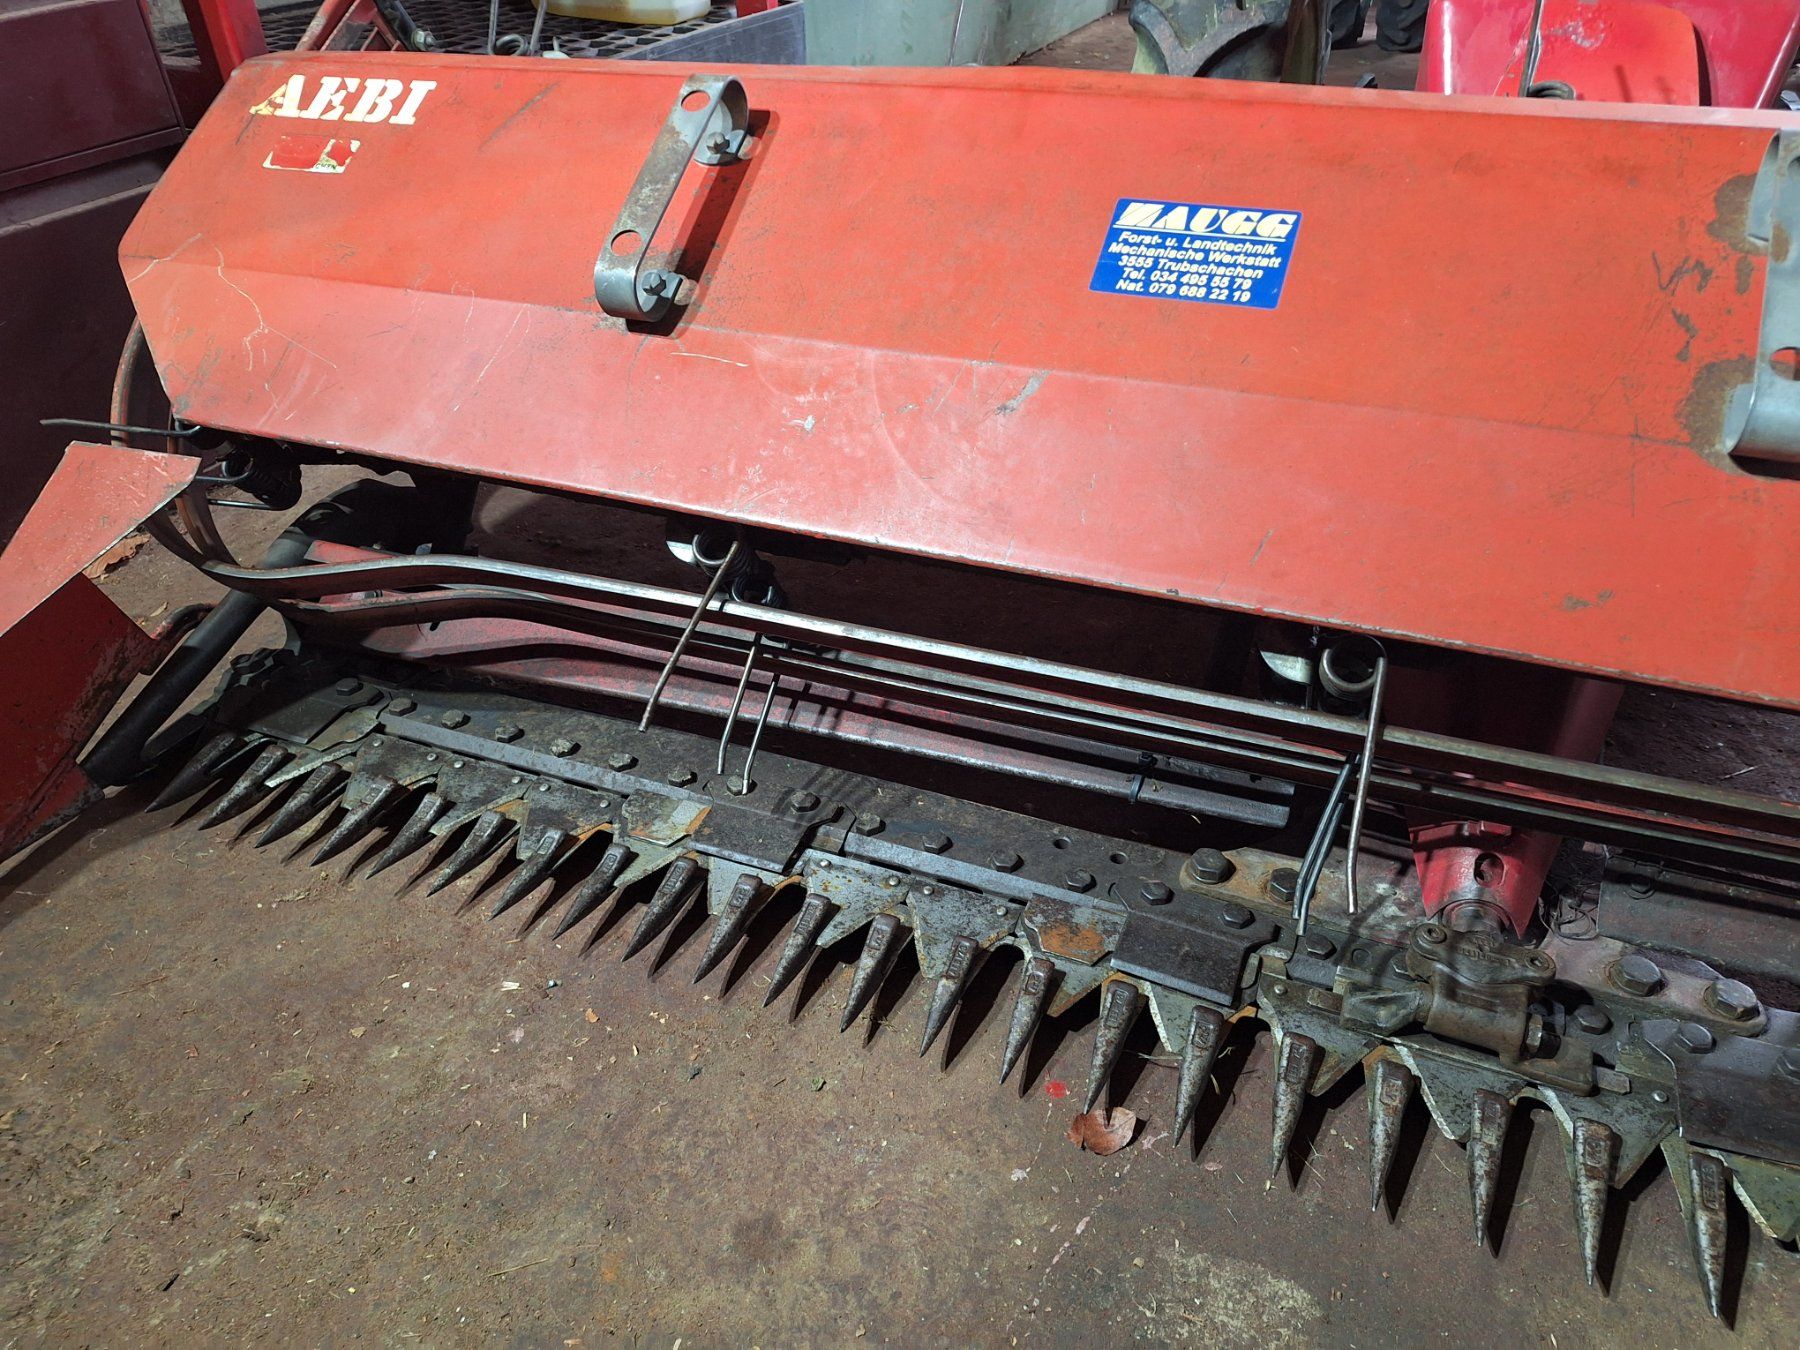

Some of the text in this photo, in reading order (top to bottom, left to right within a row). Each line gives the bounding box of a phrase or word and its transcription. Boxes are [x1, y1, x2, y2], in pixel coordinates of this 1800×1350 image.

[249, 74, 437, 125] AEBI
[1115, 202, 1298, 238] ZAUGG
[1108, 242, 1281, 268] Mechanische Werkstatt
[1118, 231, 1278, 255] Forst- u. Landtechnik
[1118, 255, 1264, 279] 3555 Trubschachen
[1123, 268, 1253, 290] Tel. 034 495 55 79
[1115, 279, 1251, 302] Nat. 079 688 22 19
